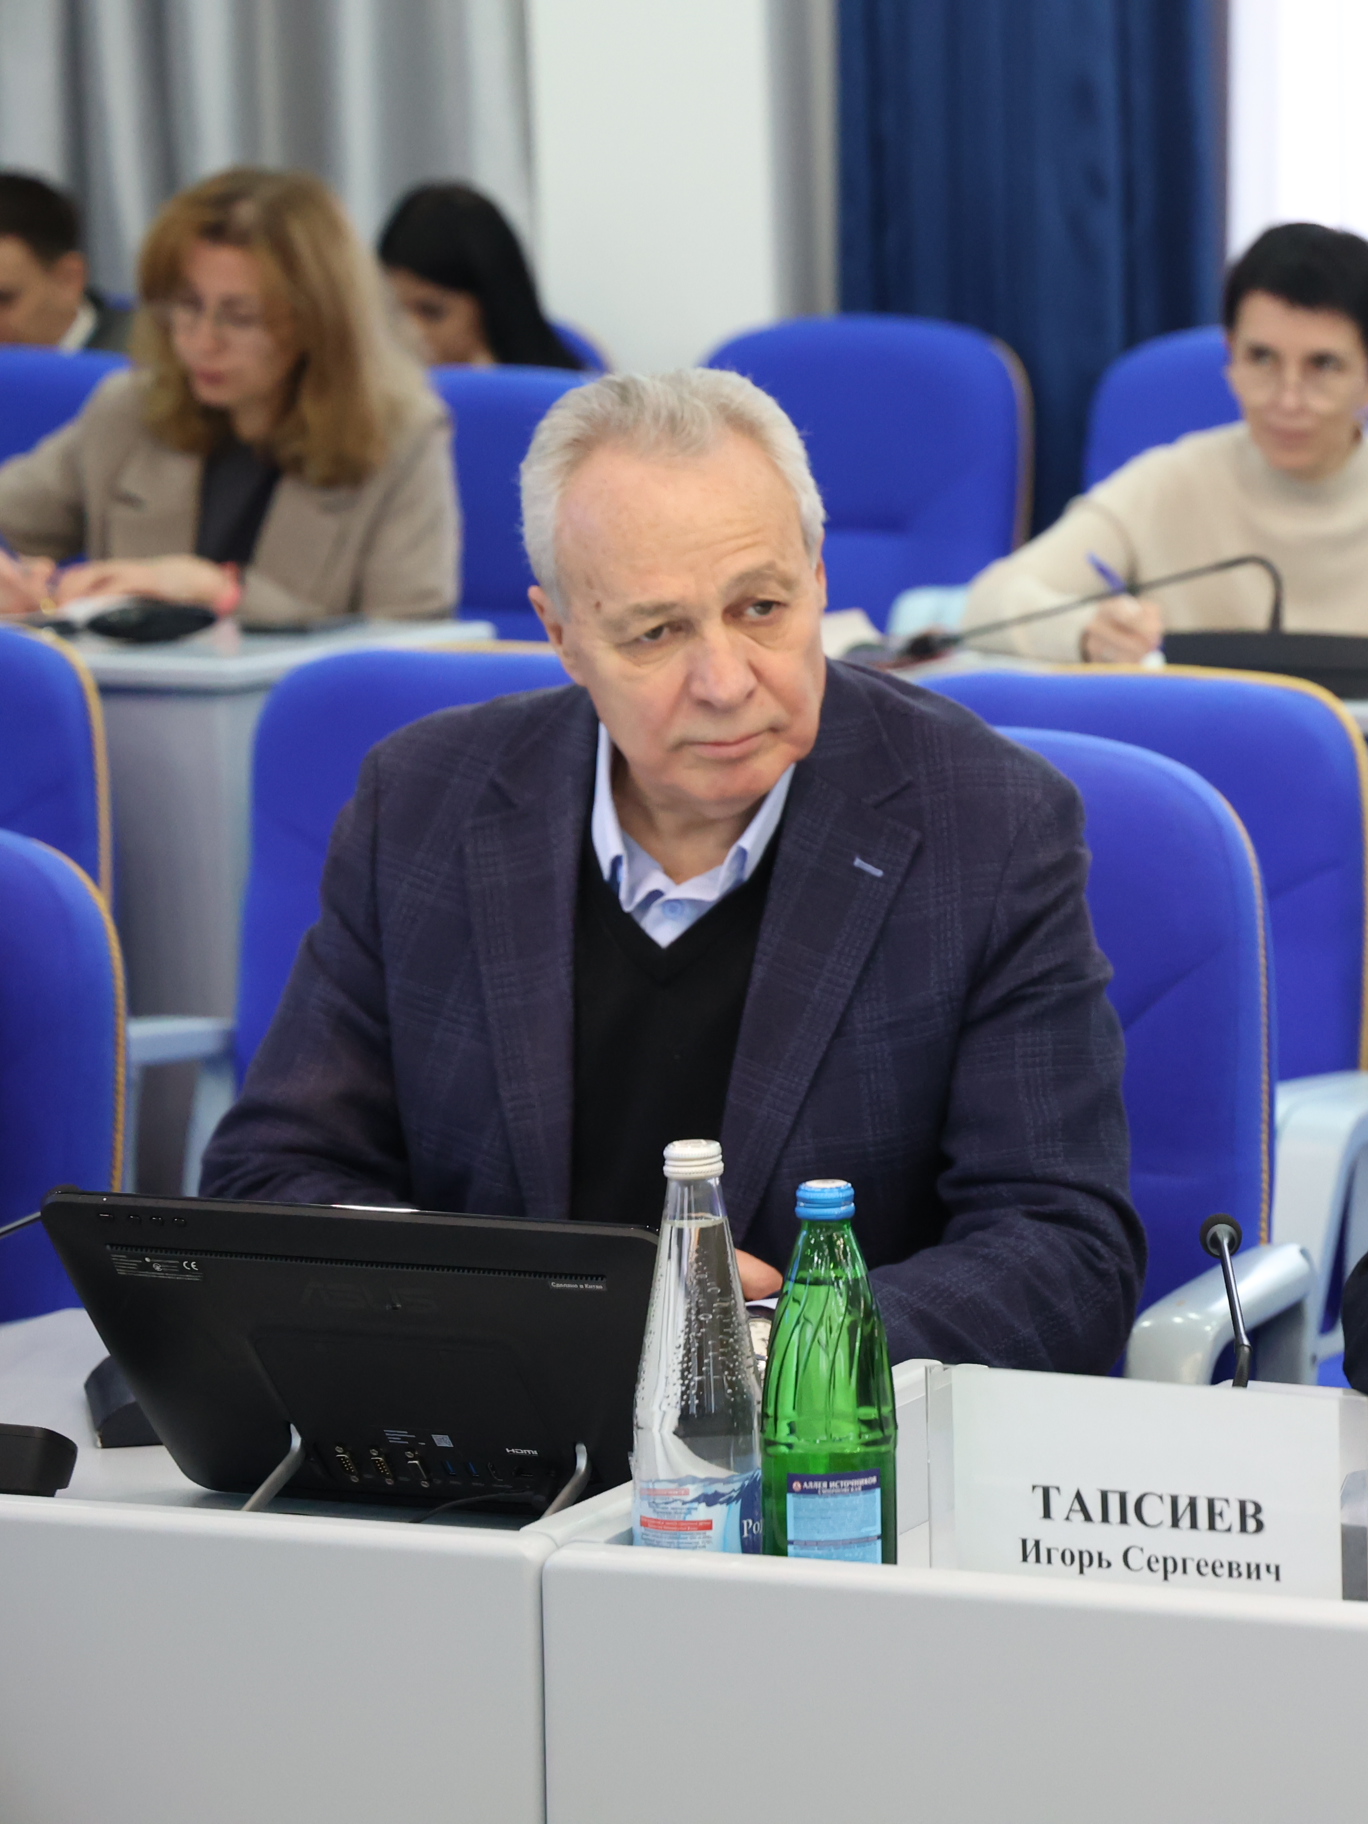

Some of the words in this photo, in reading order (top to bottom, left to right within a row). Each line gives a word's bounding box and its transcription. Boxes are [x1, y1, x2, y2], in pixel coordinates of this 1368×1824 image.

[505, 1447, 539, 1456] HDMI
[1031, 1484, 1265, 1535] ТАПСИЕВ
[1018, 1536, 1113, 1576] Игорь
[1121, 1544, 1282, 1583] Сергеевич
